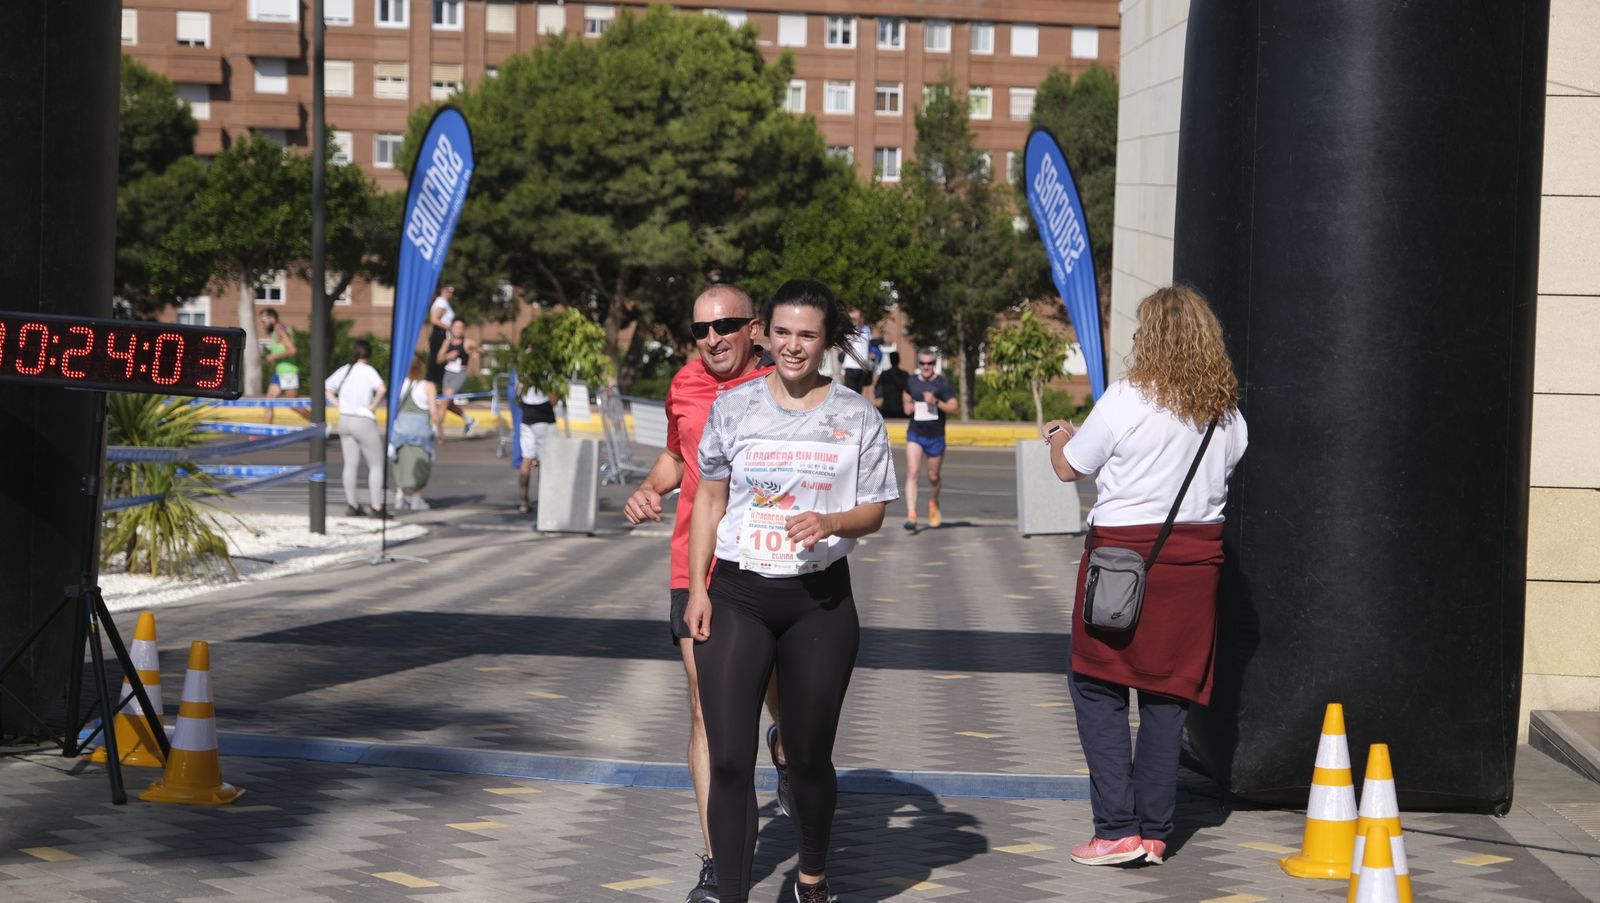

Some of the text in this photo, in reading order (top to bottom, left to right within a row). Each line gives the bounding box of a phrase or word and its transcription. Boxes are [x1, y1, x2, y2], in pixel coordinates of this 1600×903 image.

[0, 322, 228, 388] 0:24:03
[795, 451, 812, 461] SIN
[814, 452, 839, 463] HUMO
